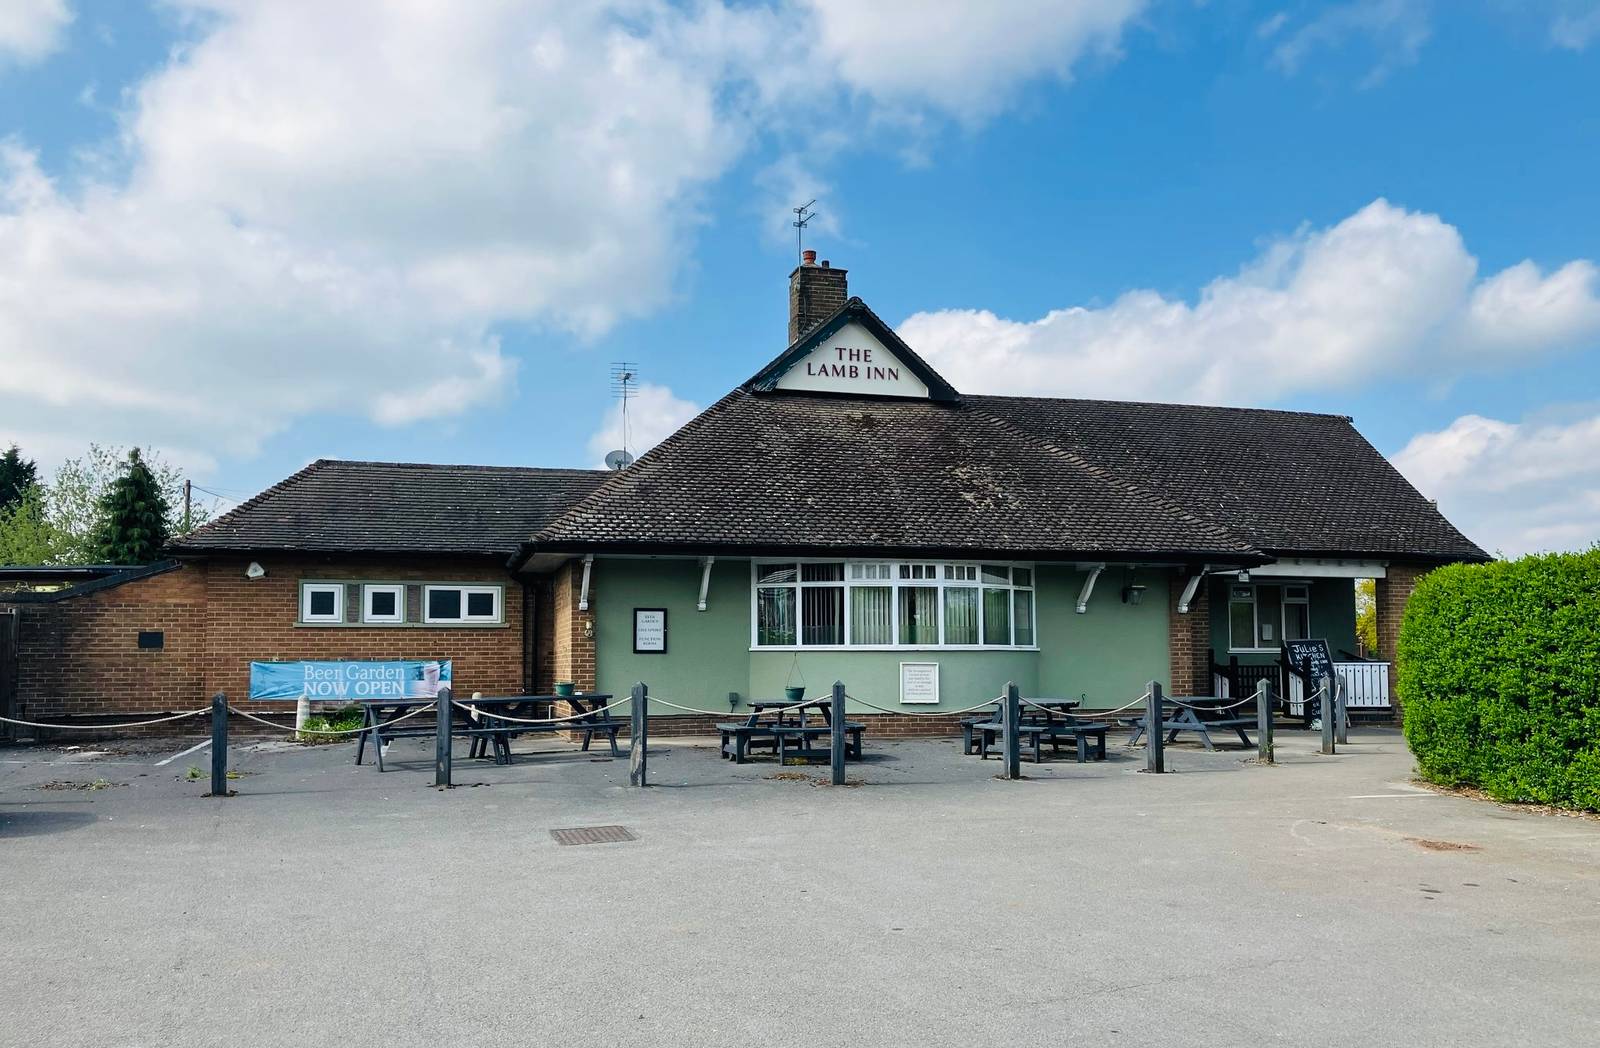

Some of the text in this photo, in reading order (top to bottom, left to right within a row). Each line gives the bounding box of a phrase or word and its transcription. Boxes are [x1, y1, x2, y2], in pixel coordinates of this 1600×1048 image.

[835, 347, 872, 363] THE
[807, 362, 899, 381] LAMB INN
[303, 664, 405, 680] Beer Garden
[303, 681, 405, 695] NOW OPEN
